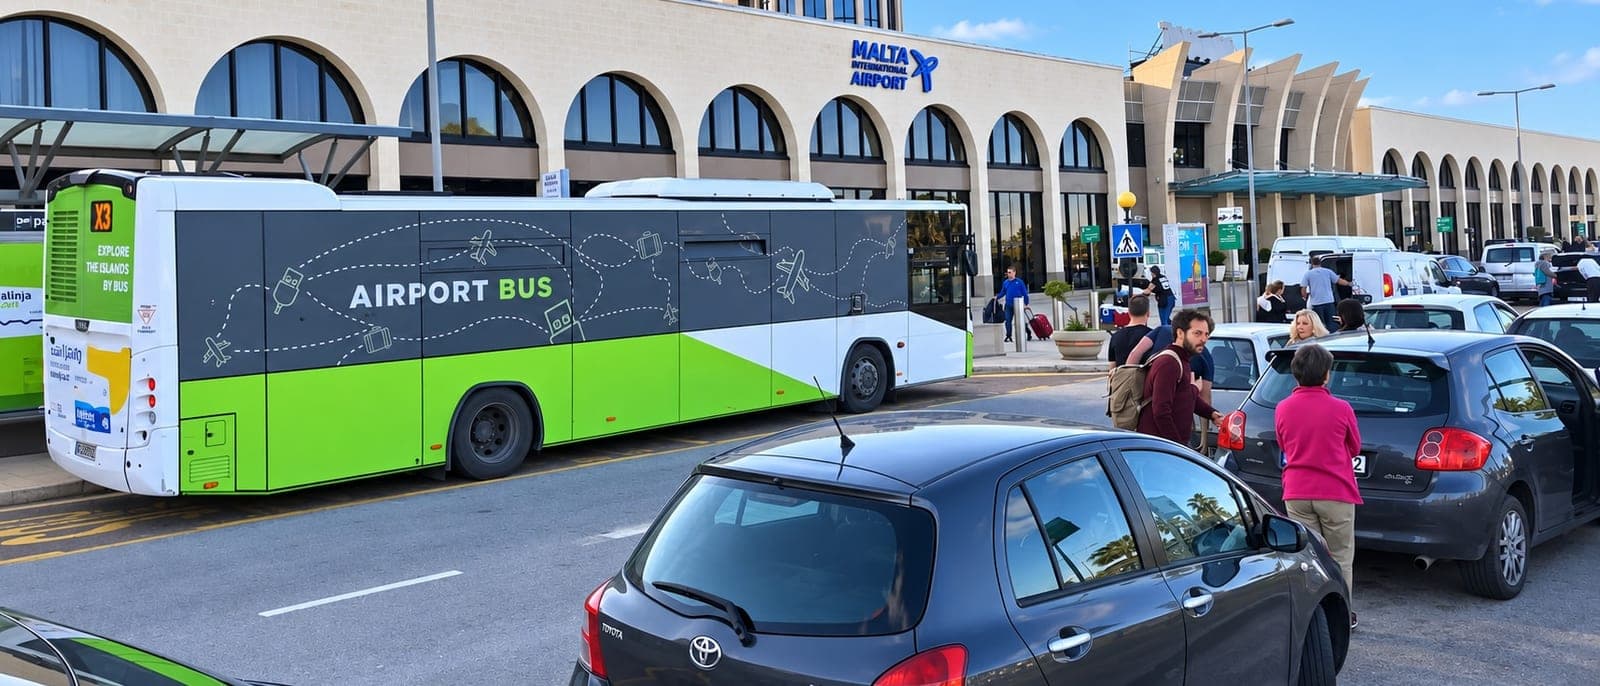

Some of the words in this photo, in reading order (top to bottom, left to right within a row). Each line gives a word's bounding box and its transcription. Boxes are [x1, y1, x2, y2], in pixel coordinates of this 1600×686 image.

[852, 39, 909, 66] MALTA
[851, 60, 908, 75] INTERNATIONAL
[850, 71, 908, 91] AIRPORT
[95, 203, 111, 230] X3
[98, 245, 129, 257] EXPLORE
[87, 262, 98, 273] THE
[100, 262, 129, 275] ISLANDS
[103, 280, 112, 291] BY
[113, 281, 128, 292] BUS
[350, 279, 489, 309] AIRPORT
[499, 276, 552, 300] BUS
[601, 622, 623, 640] TOYOTA
